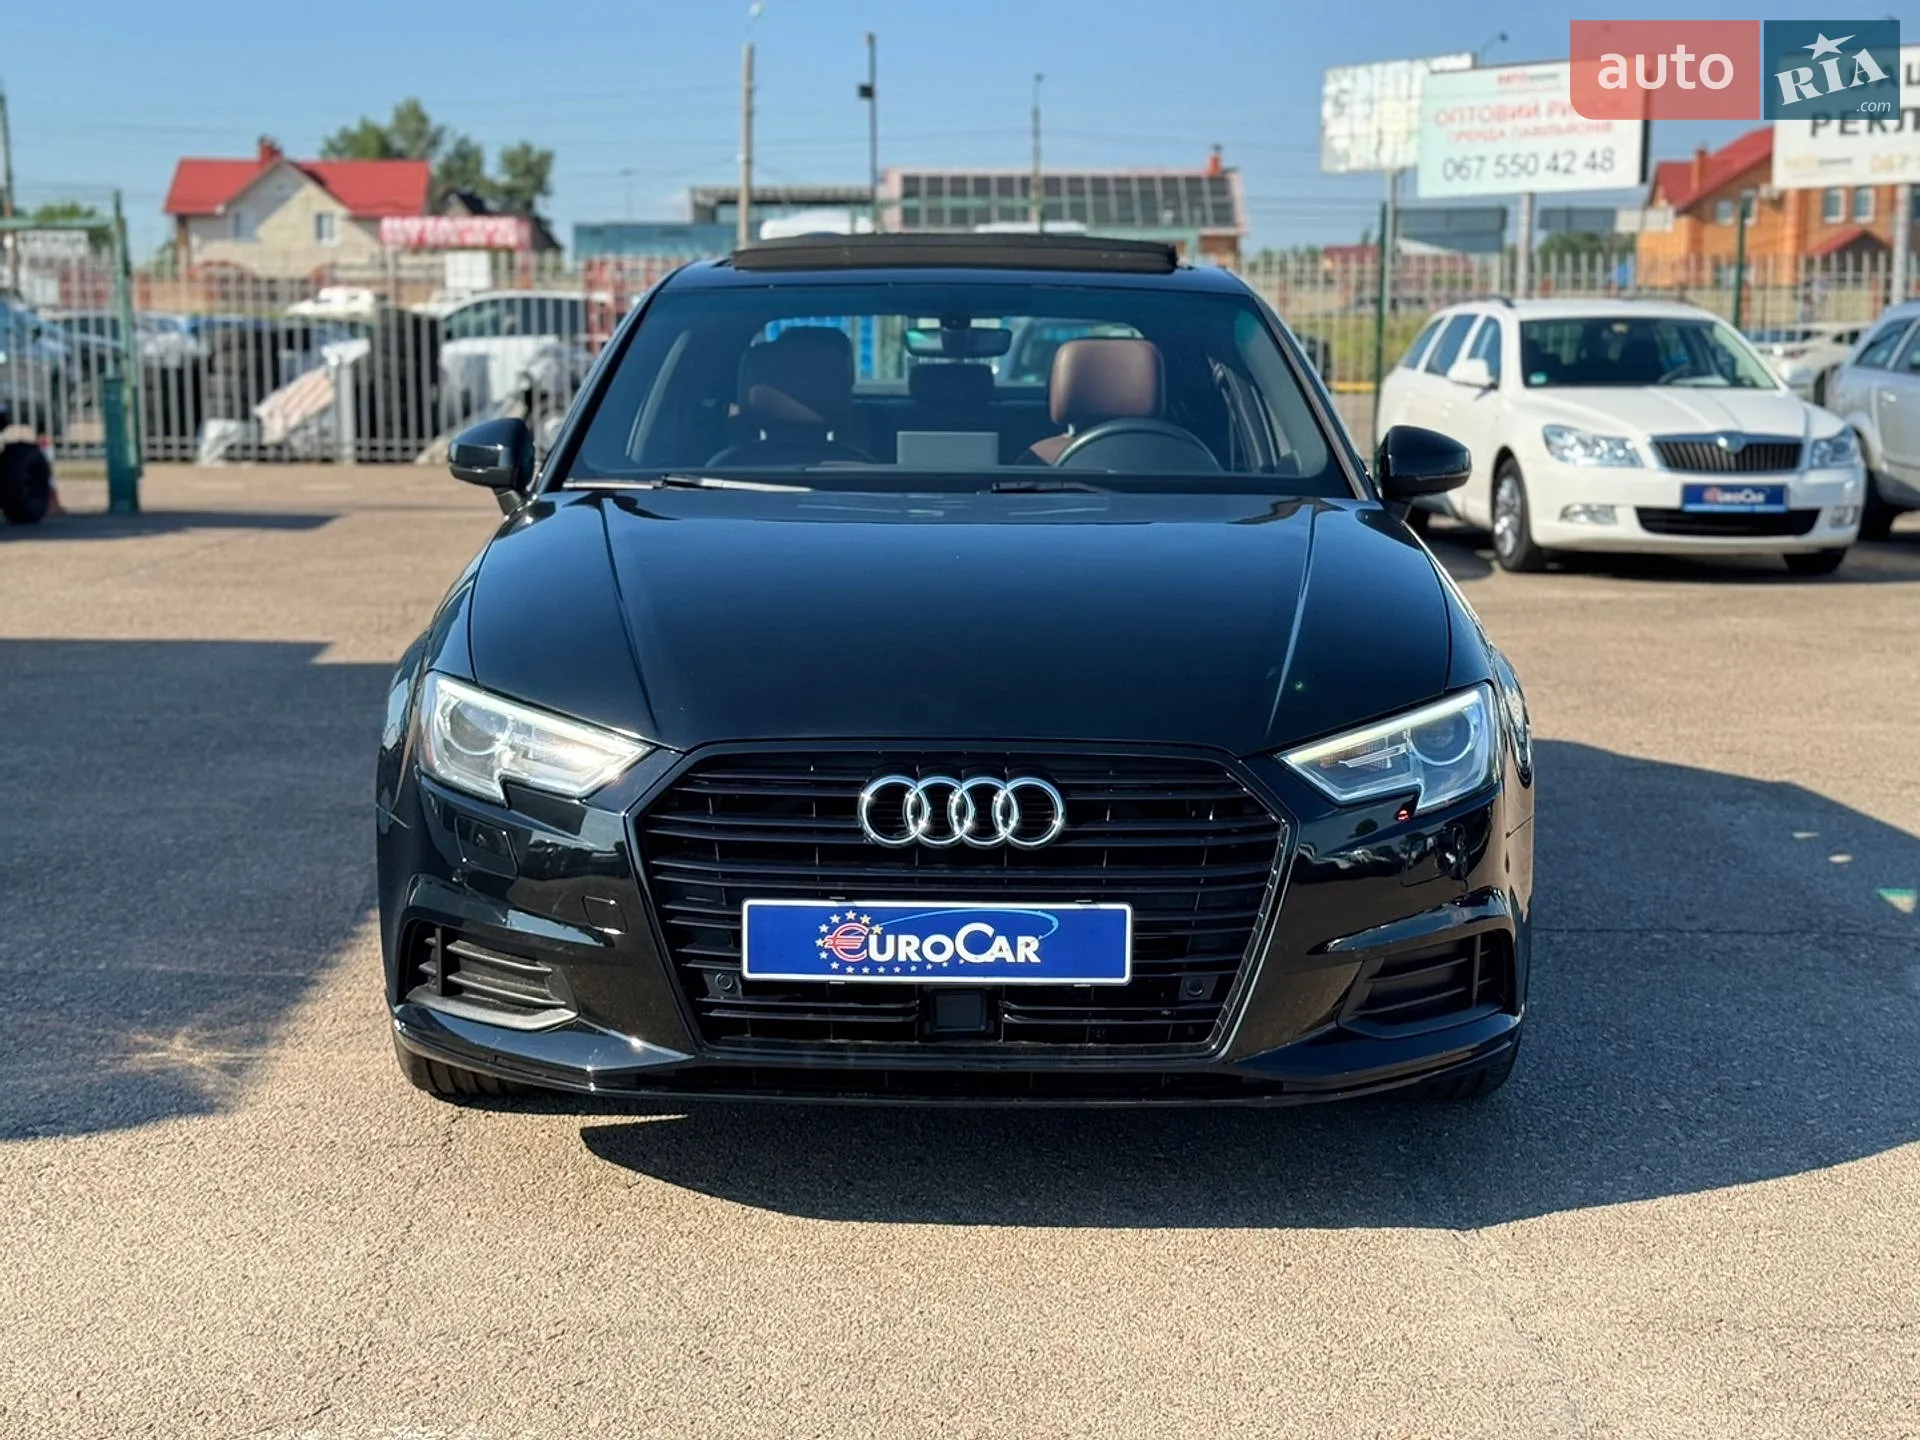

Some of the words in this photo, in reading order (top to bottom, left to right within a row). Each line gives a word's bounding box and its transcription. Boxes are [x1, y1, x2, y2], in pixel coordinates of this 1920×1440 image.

[1443, 155, 1487, 181] 067
[1494, 152, 1540, 178] 550
[1546, 150, 1577, 175] 42
[1584, 147, 1615, 173] 48
